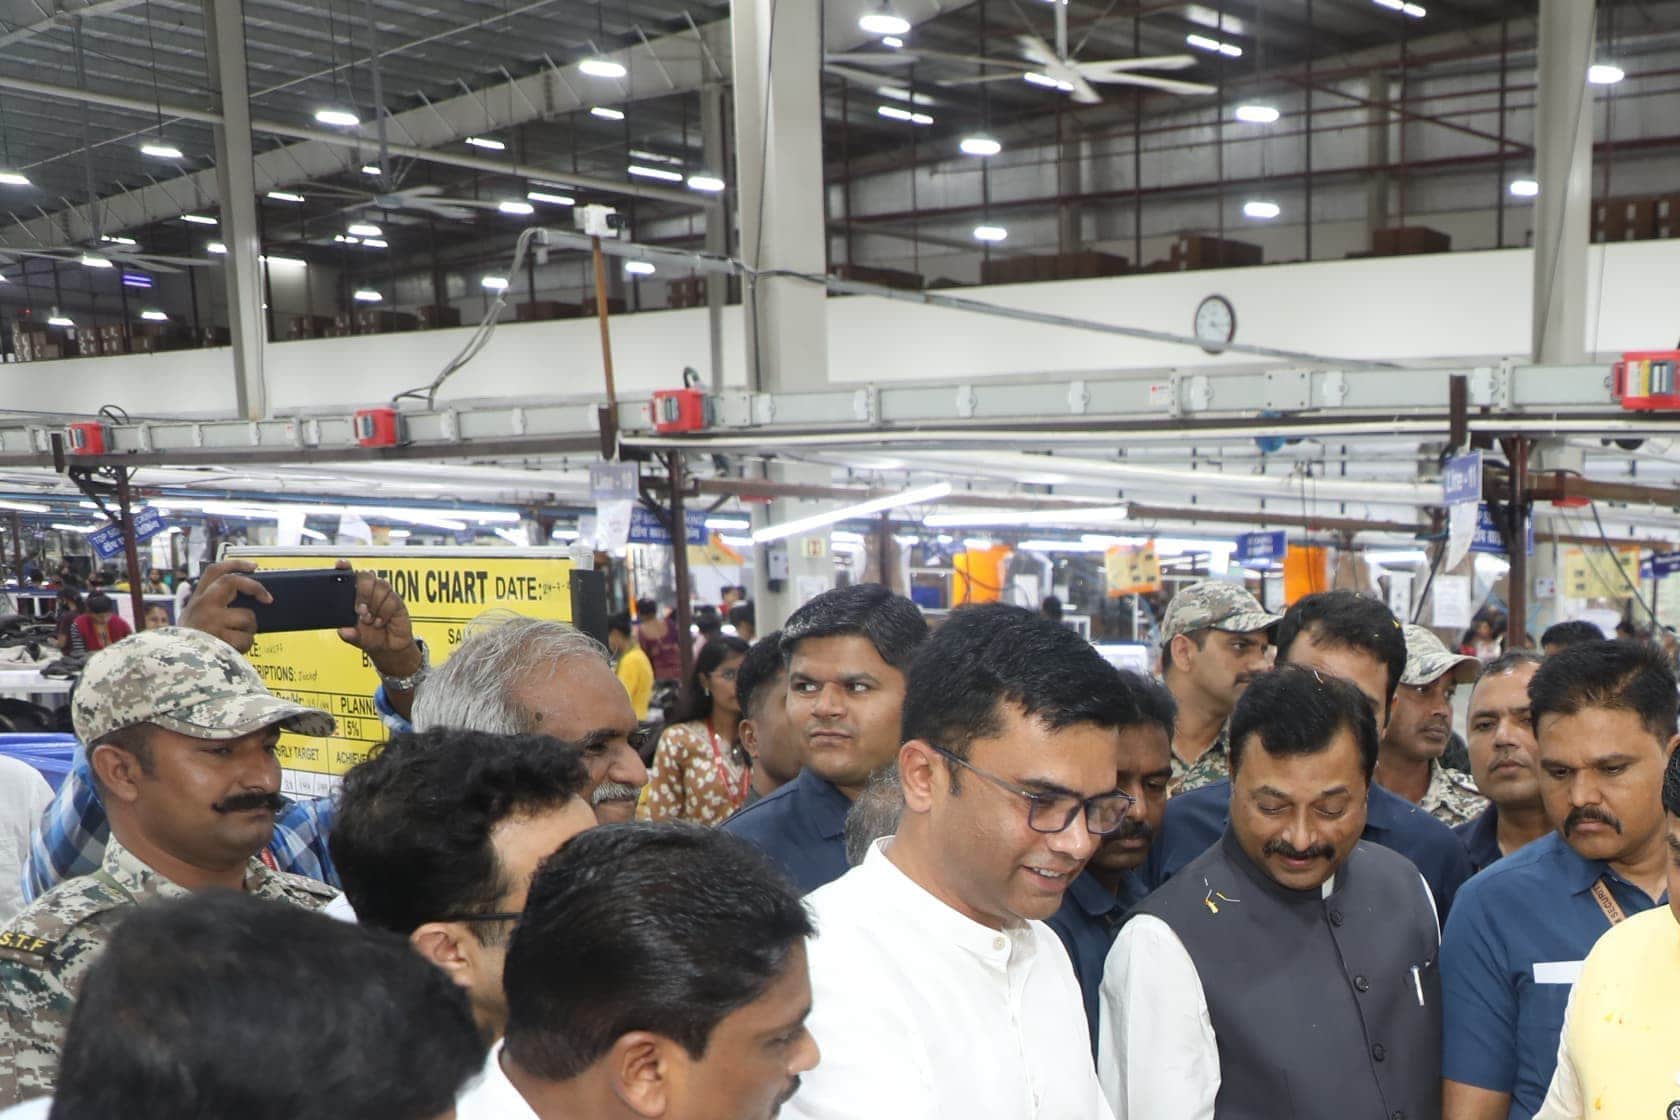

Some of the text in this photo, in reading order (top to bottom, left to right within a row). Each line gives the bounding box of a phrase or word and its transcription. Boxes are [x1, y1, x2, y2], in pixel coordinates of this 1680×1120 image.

[425, 569, 488, 604] CHART
[496, 576, 544, 600] DATE:
[253, 663, 297, 682] RIPTIONS:
[347, 720, 360, 737] 5%
[294, 746, 320, 761] TARGET
